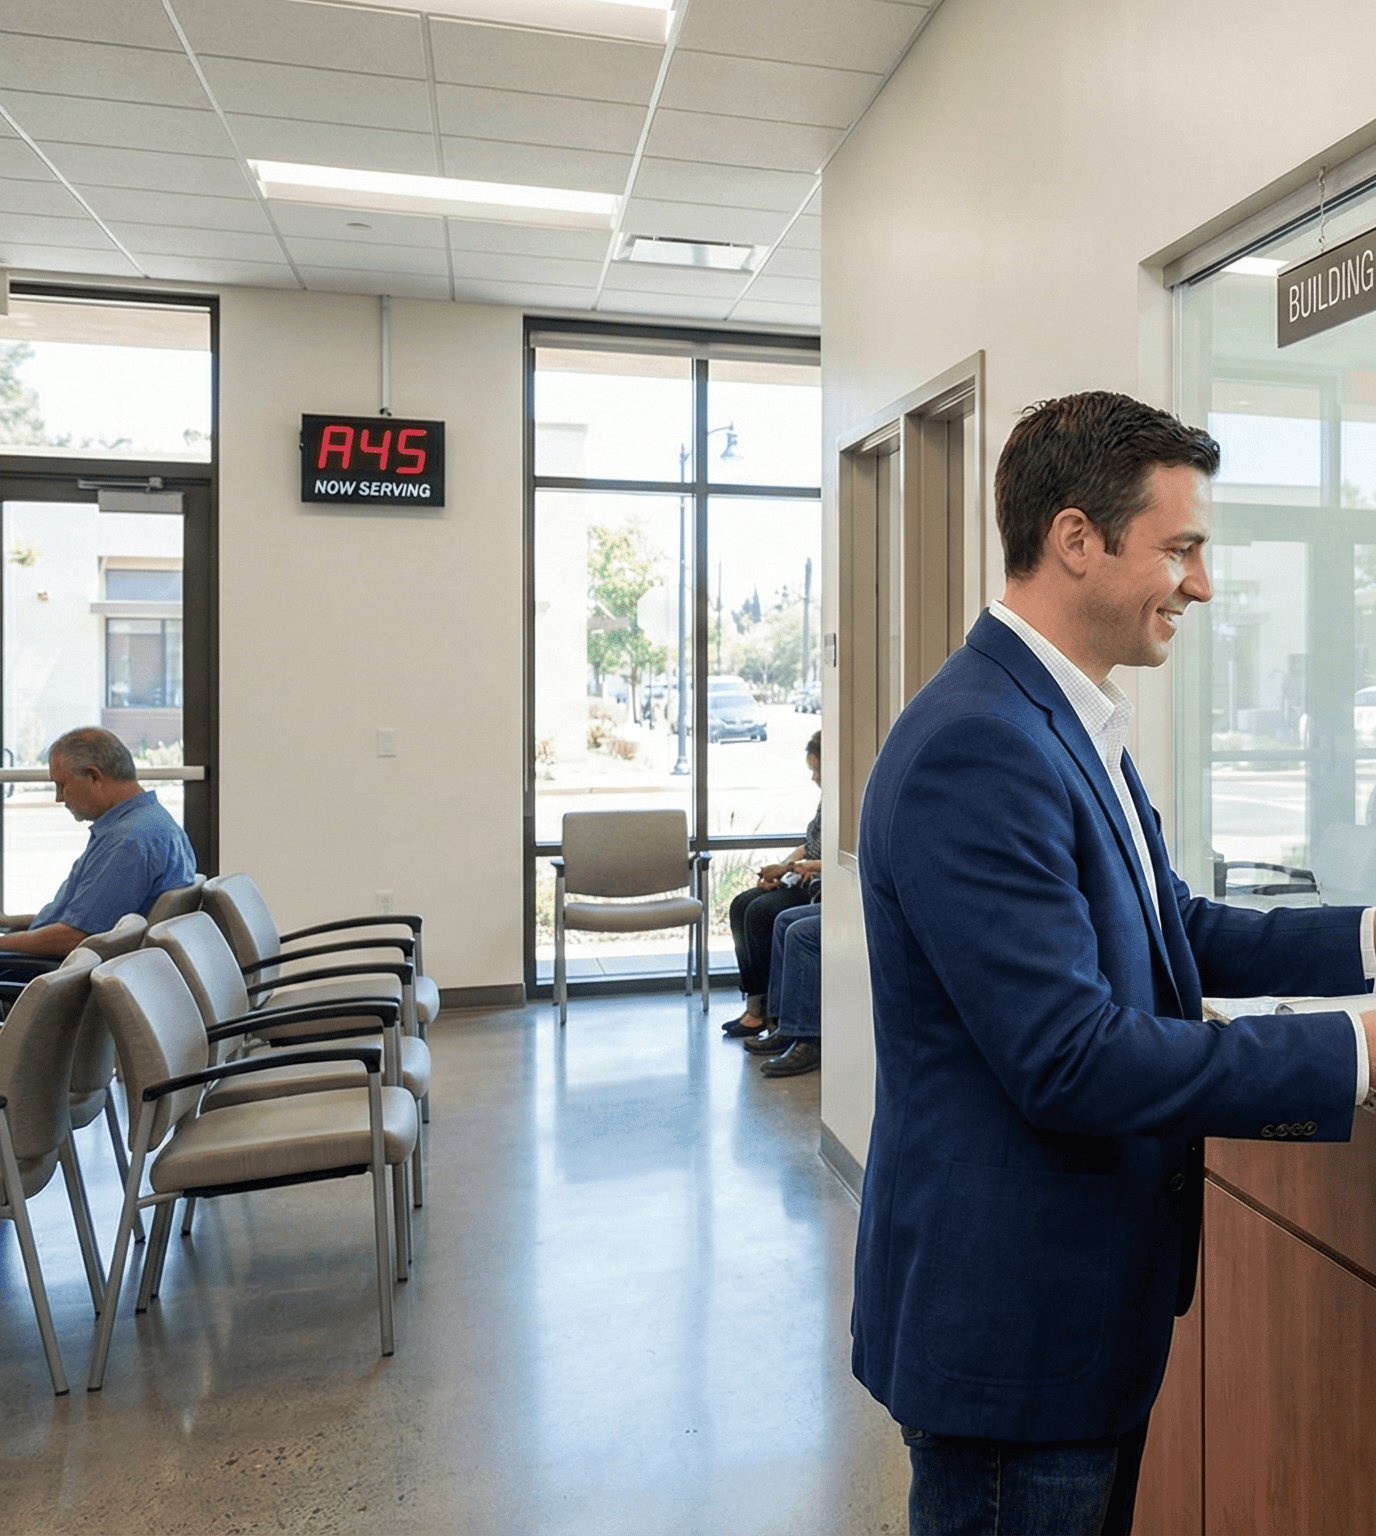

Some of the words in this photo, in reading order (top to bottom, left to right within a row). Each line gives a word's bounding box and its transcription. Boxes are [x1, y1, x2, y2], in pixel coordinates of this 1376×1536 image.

[1288, 249, 1374, 323] BUILDING
[318, 425, 426, 474] A45
[314, 479, 357, 496] NOW
[359, 482, 431, 498] SERVING
